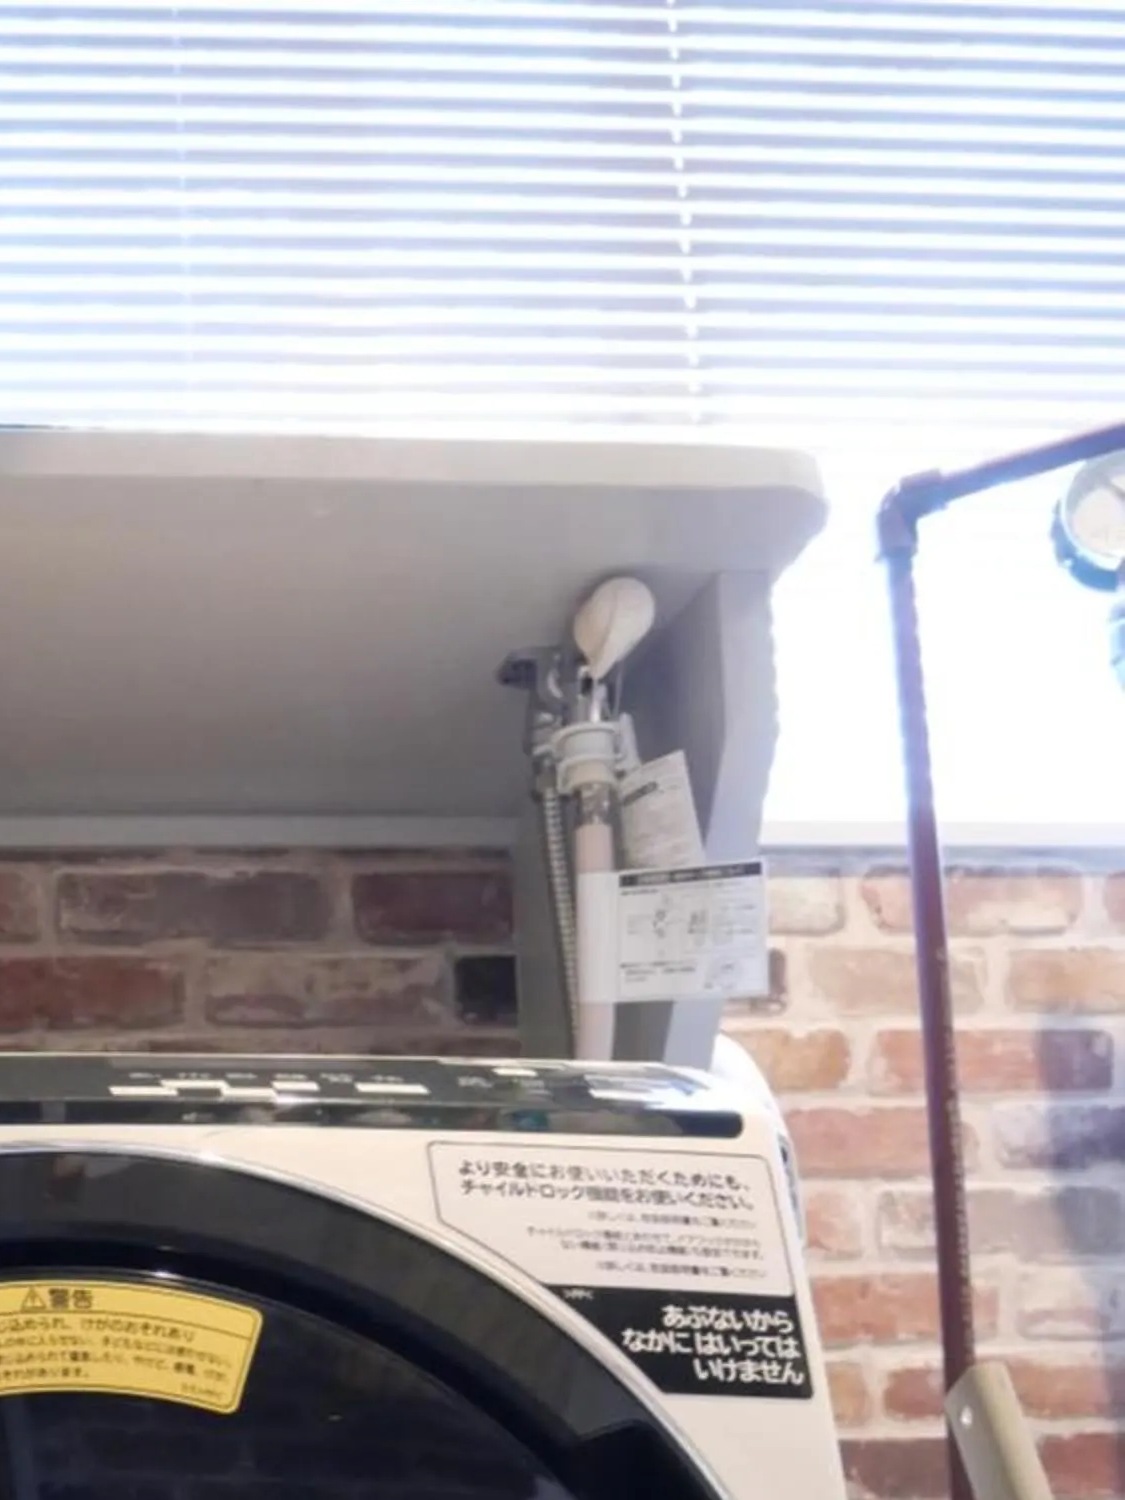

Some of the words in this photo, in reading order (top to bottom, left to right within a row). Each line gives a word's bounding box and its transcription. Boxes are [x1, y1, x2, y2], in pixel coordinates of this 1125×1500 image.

[660, 1304, 794, 1334] あぶないから
[692, 1357, 805, 1386] いけません
